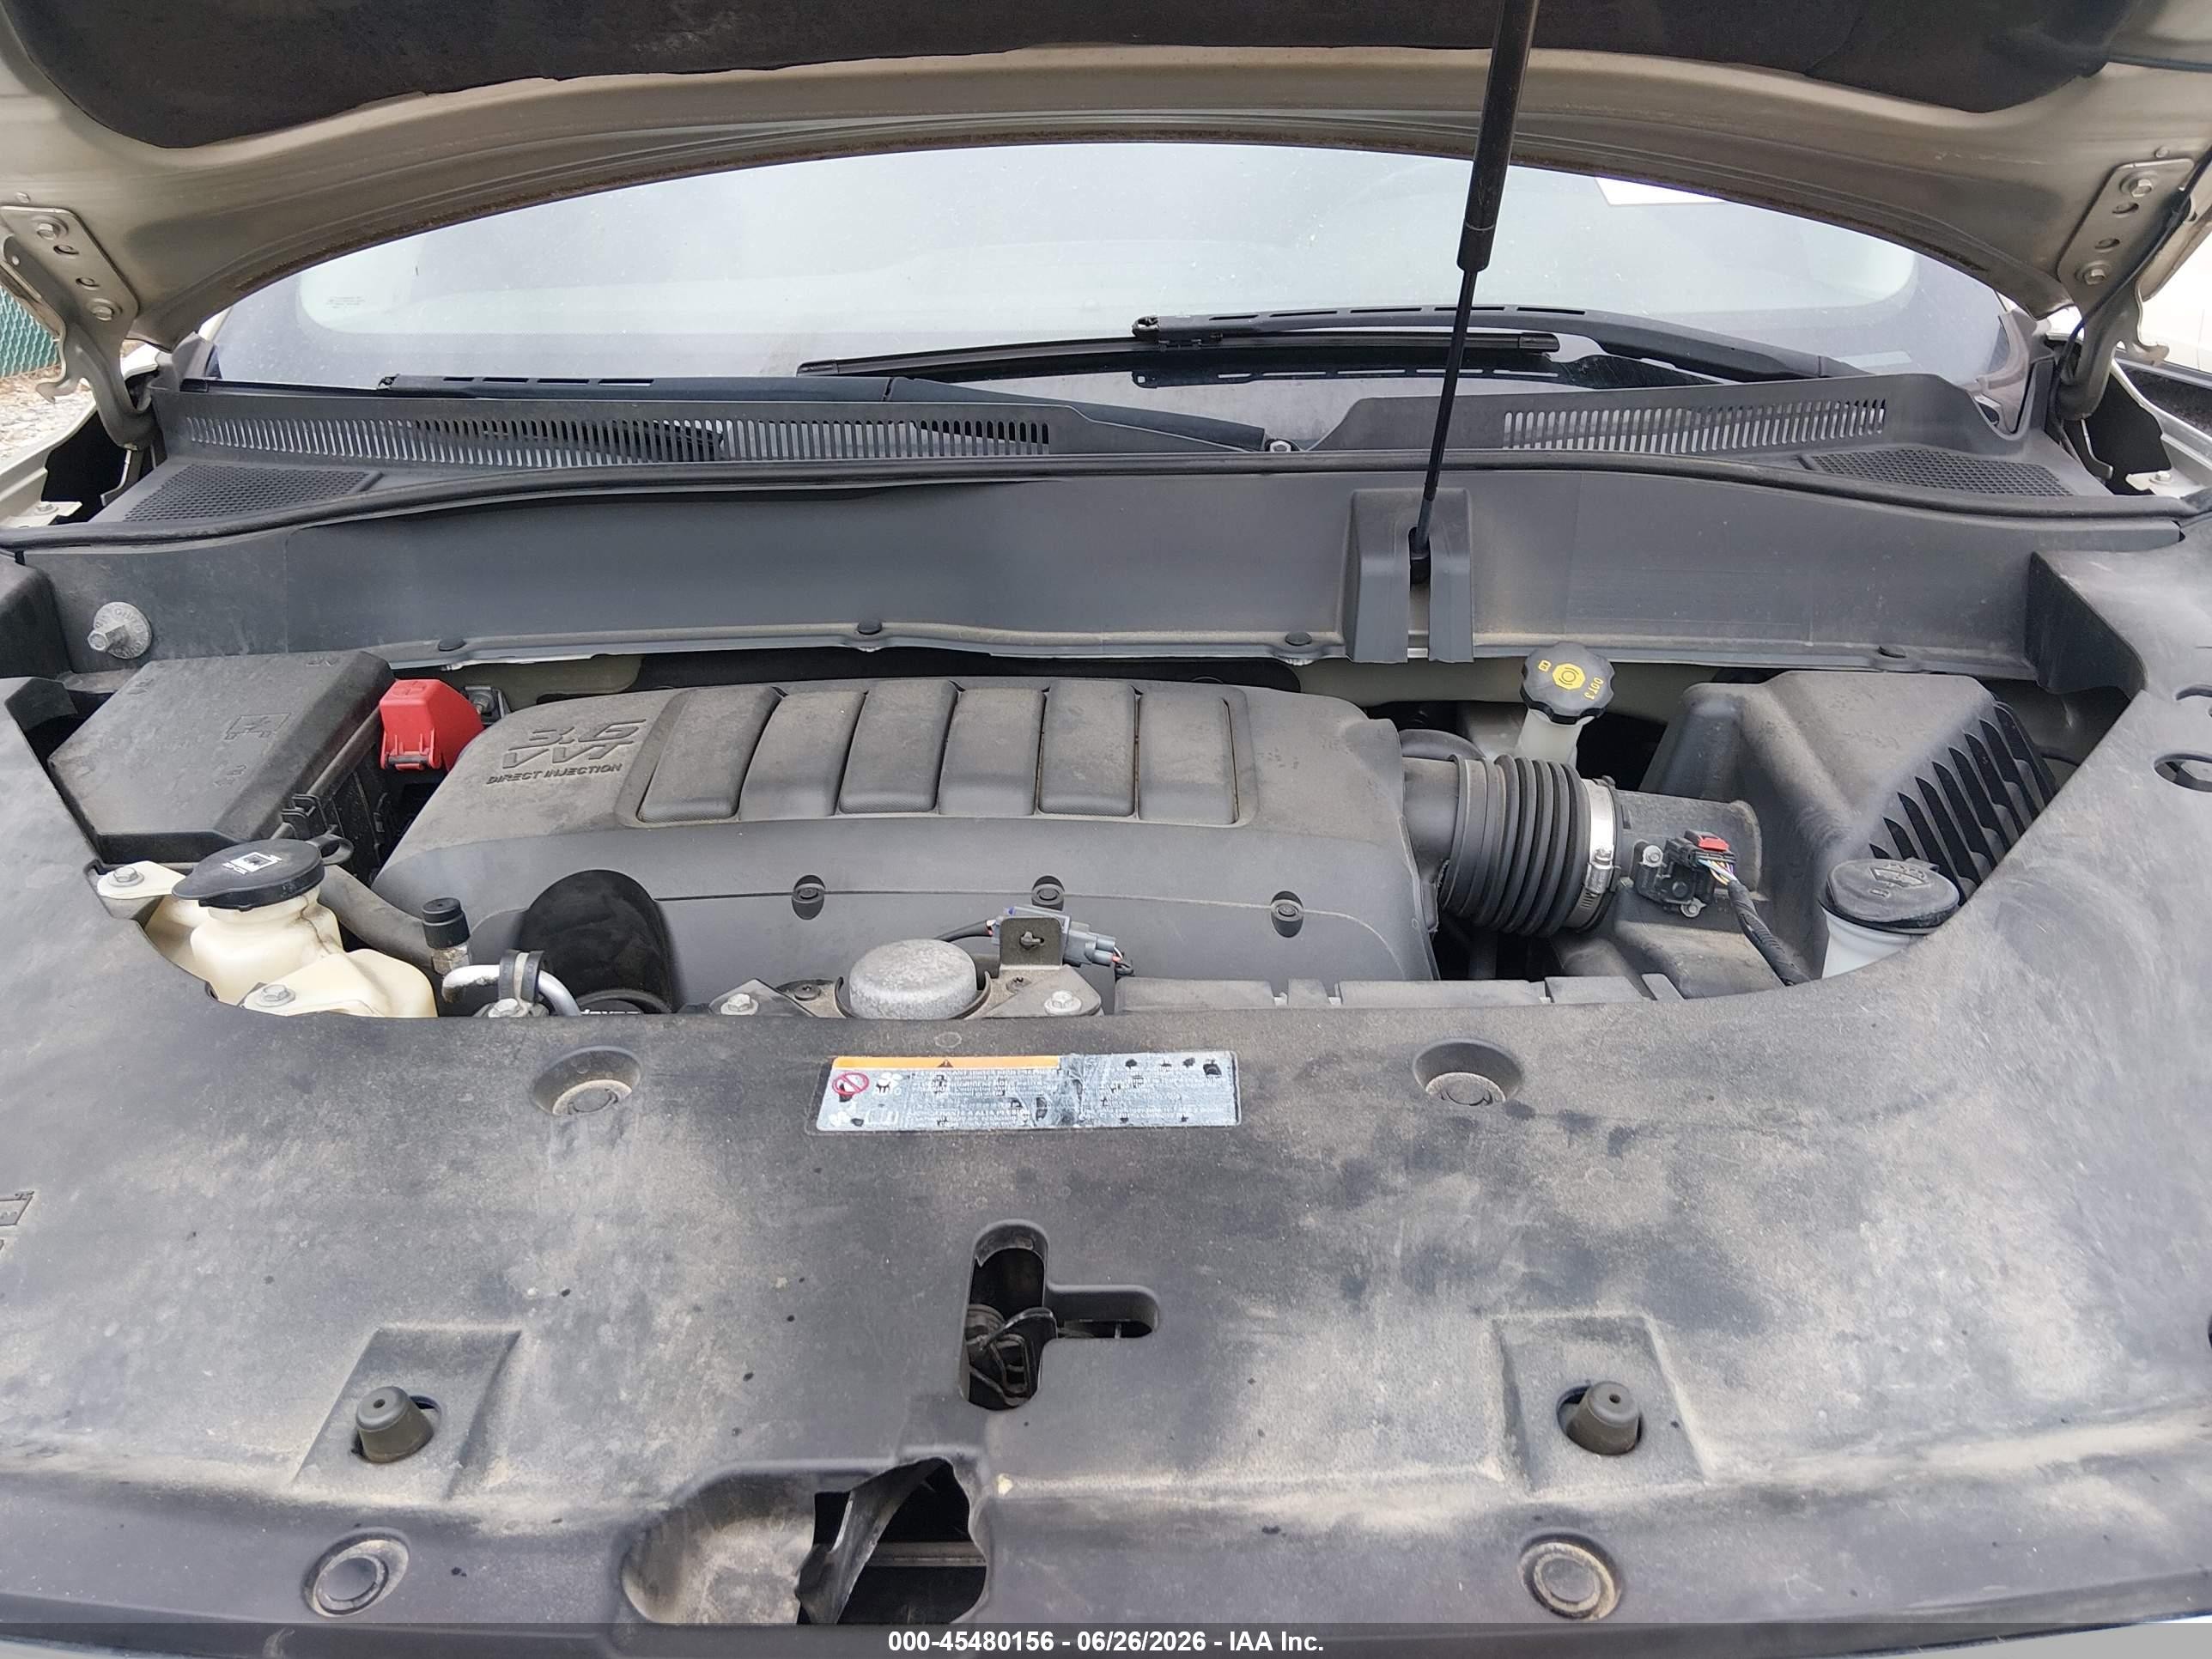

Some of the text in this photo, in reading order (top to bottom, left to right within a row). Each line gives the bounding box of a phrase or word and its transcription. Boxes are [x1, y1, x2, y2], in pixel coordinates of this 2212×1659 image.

[507, 718, 647, 751] 3.6
[501, 740, 635, 769] VVT
[485, 763, 623, 785] DIRECT INJECTION
